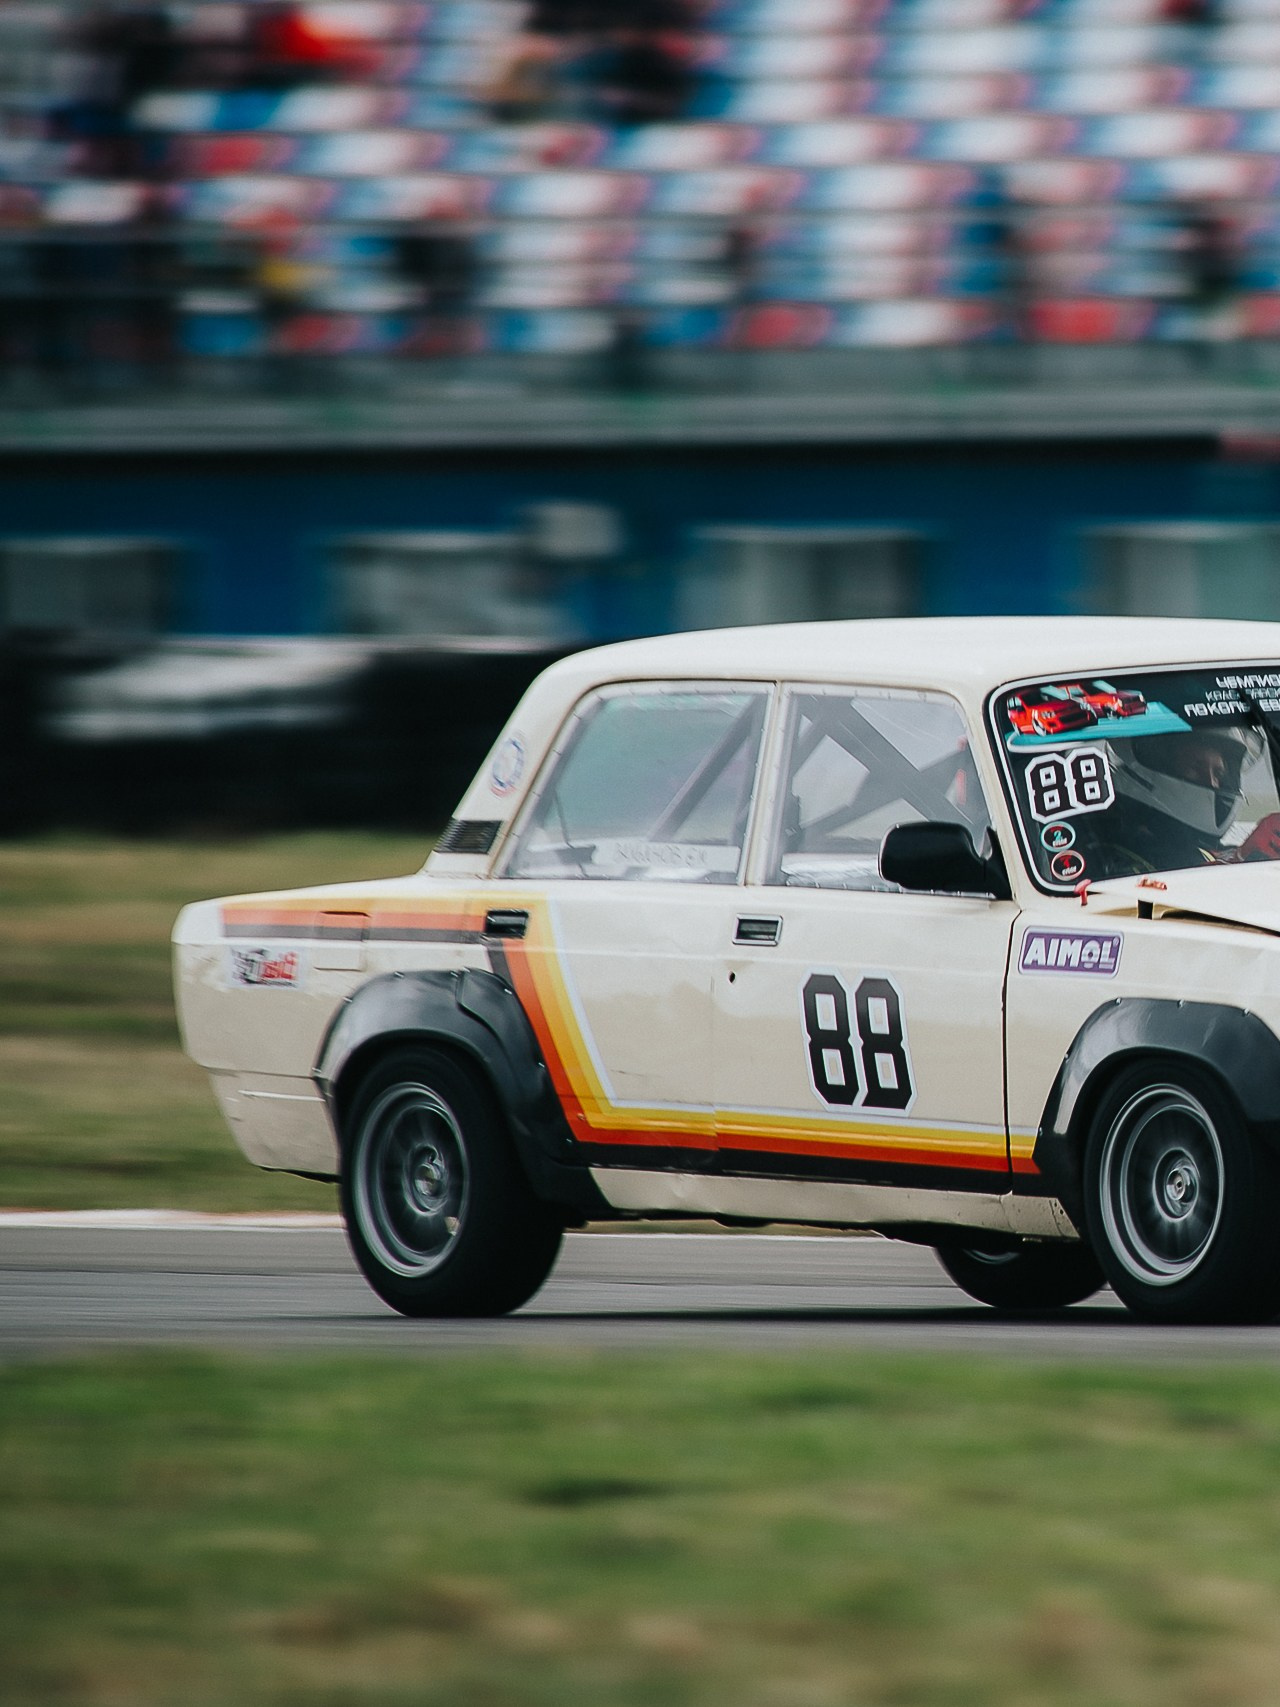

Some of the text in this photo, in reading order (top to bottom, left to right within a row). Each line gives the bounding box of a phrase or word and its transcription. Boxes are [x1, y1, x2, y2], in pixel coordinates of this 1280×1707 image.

[1026, 749, 1113, 822] 88
[1023, 937, 1117, 970] AIMOL
[802, 973, 913, 1111] 88
